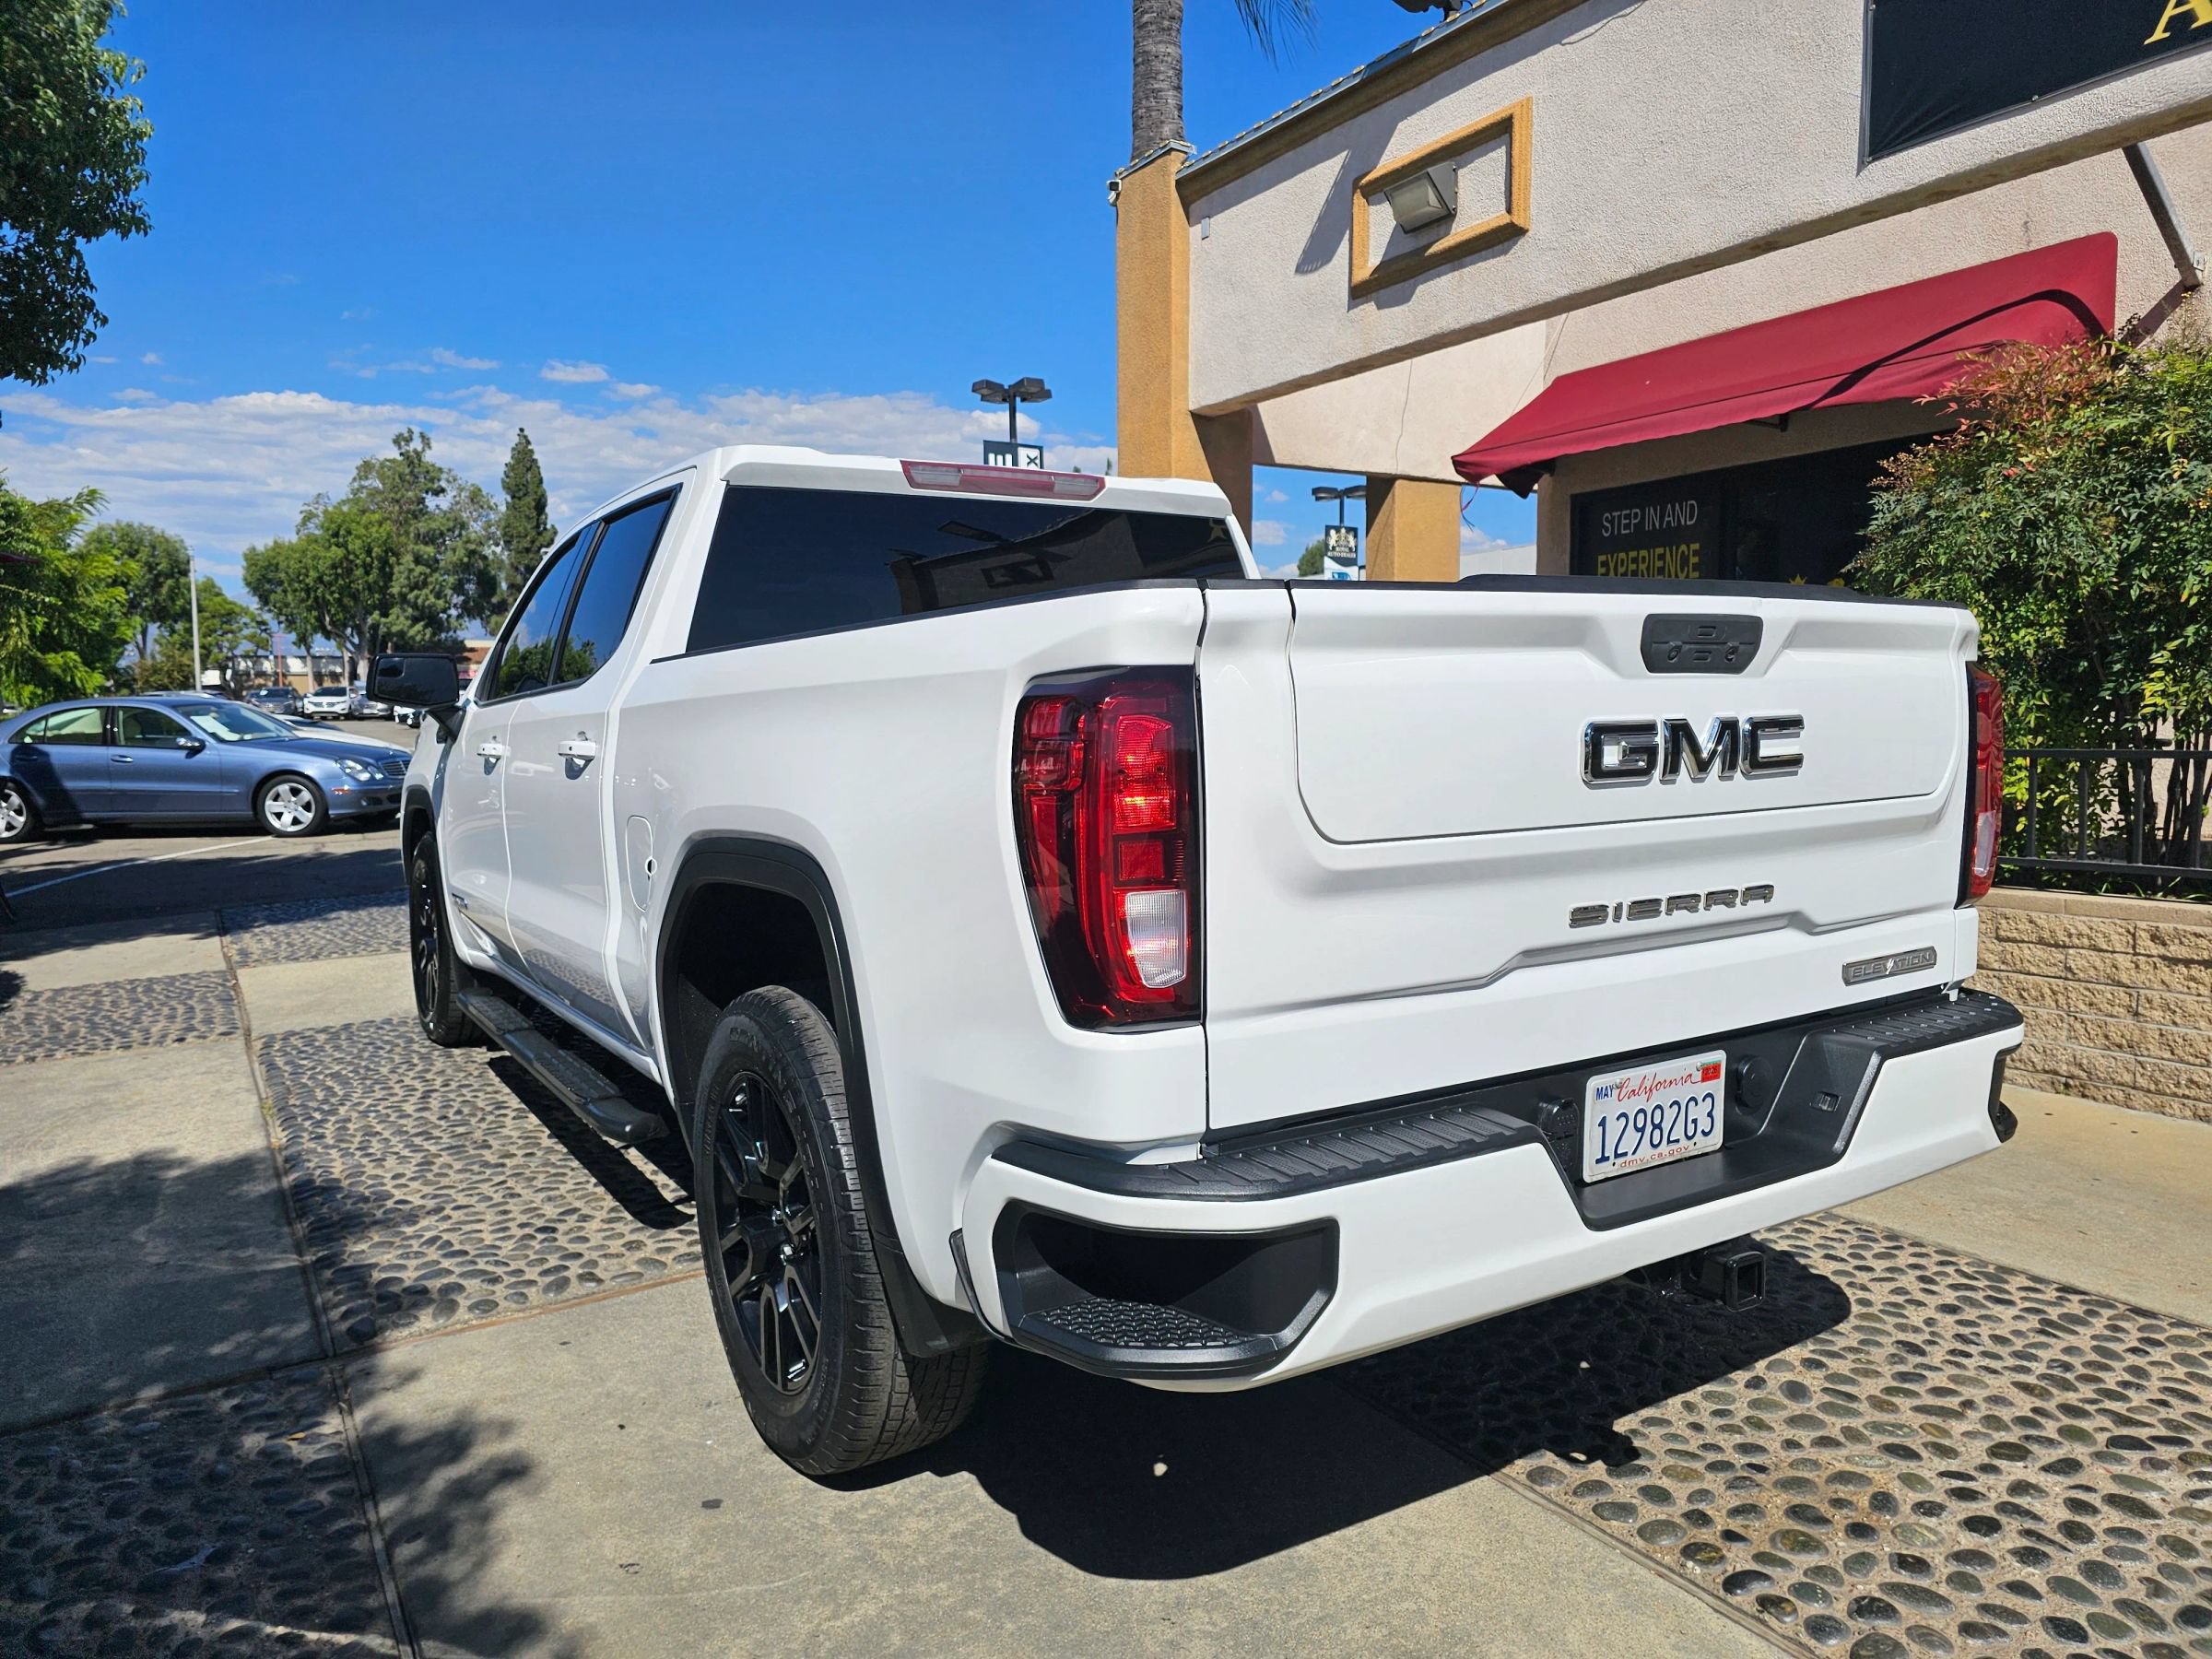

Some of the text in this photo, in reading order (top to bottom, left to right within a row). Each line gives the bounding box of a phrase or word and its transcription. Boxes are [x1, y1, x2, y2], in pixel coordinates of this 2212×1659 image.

[1602, 500, 1698, 537] STEP IN AND
[1597, 543, 1700, 579] EXPERIENCE
[1580, 713, 1805, 786] GMC
[1569, 883, 1775, 930] SIERRA
[1852, 951, 1931, 980] ELEVATION
[1595, 1071, 1702, 1102] MAY California
[1594, 1091, 1715, 1165] 12982G3
[1619, 1144, 1690, 1169] dmv.ca.gov
